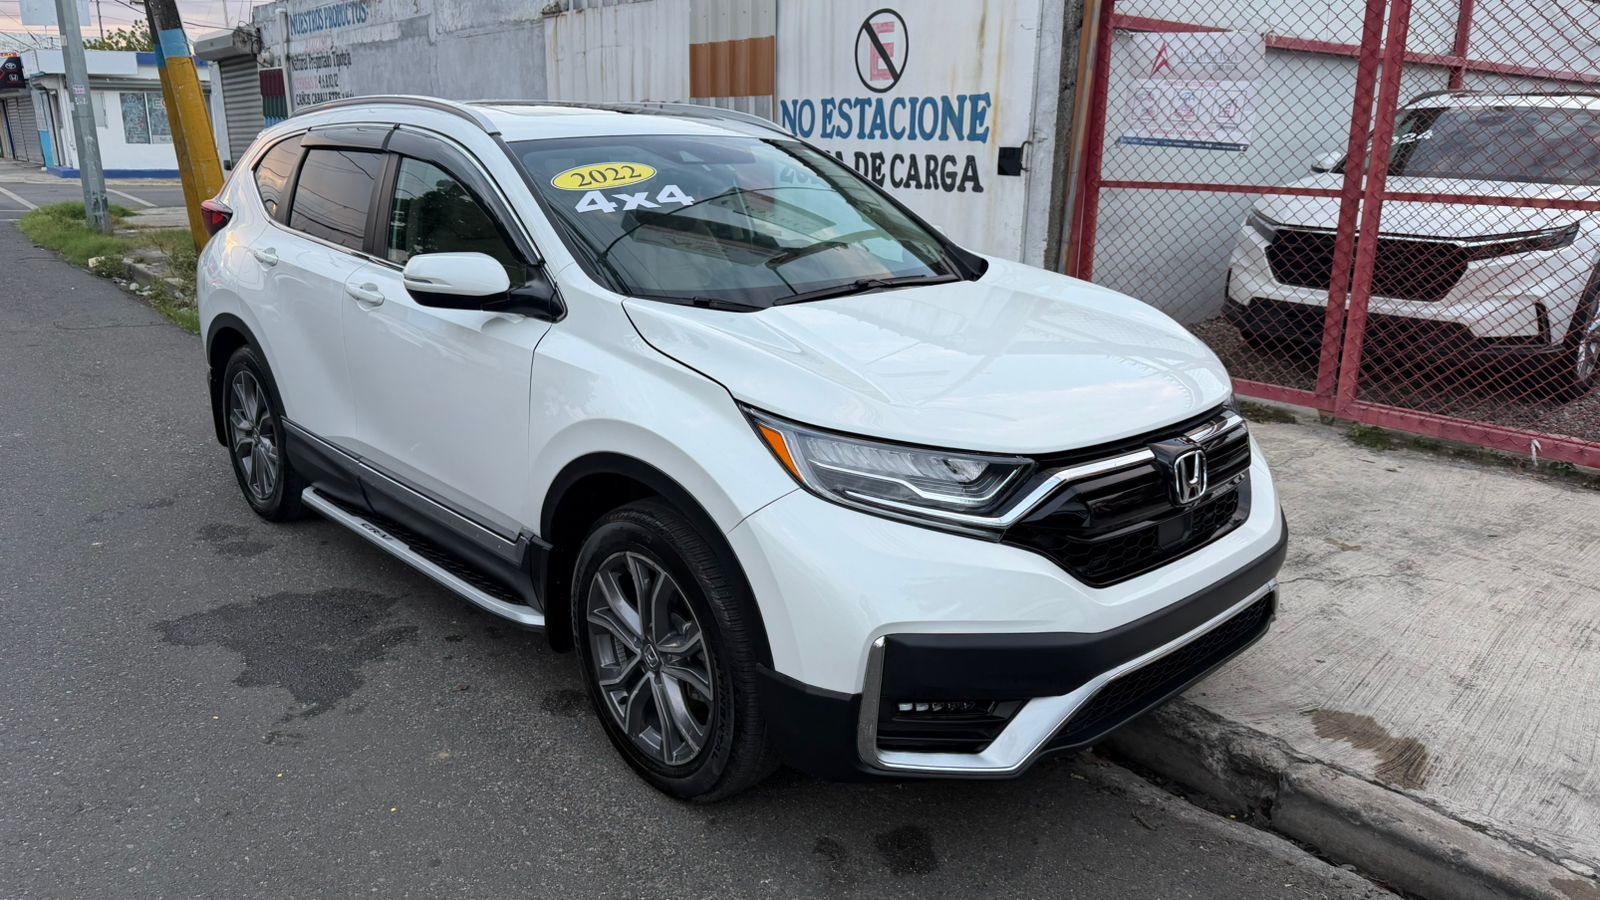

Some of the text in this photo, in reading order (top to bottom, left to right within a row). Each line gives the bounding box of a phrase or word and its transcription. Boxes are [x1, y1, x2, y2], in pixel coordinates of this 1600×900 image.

[289, 7, 324, 36] NUESTROS
[780, 92, 992, 143] NO ESTACIONE
[571, 165, 642, 188] 2022
[854, 151, 886, 188] DE
[889, 154, 984, 193] CARGA
